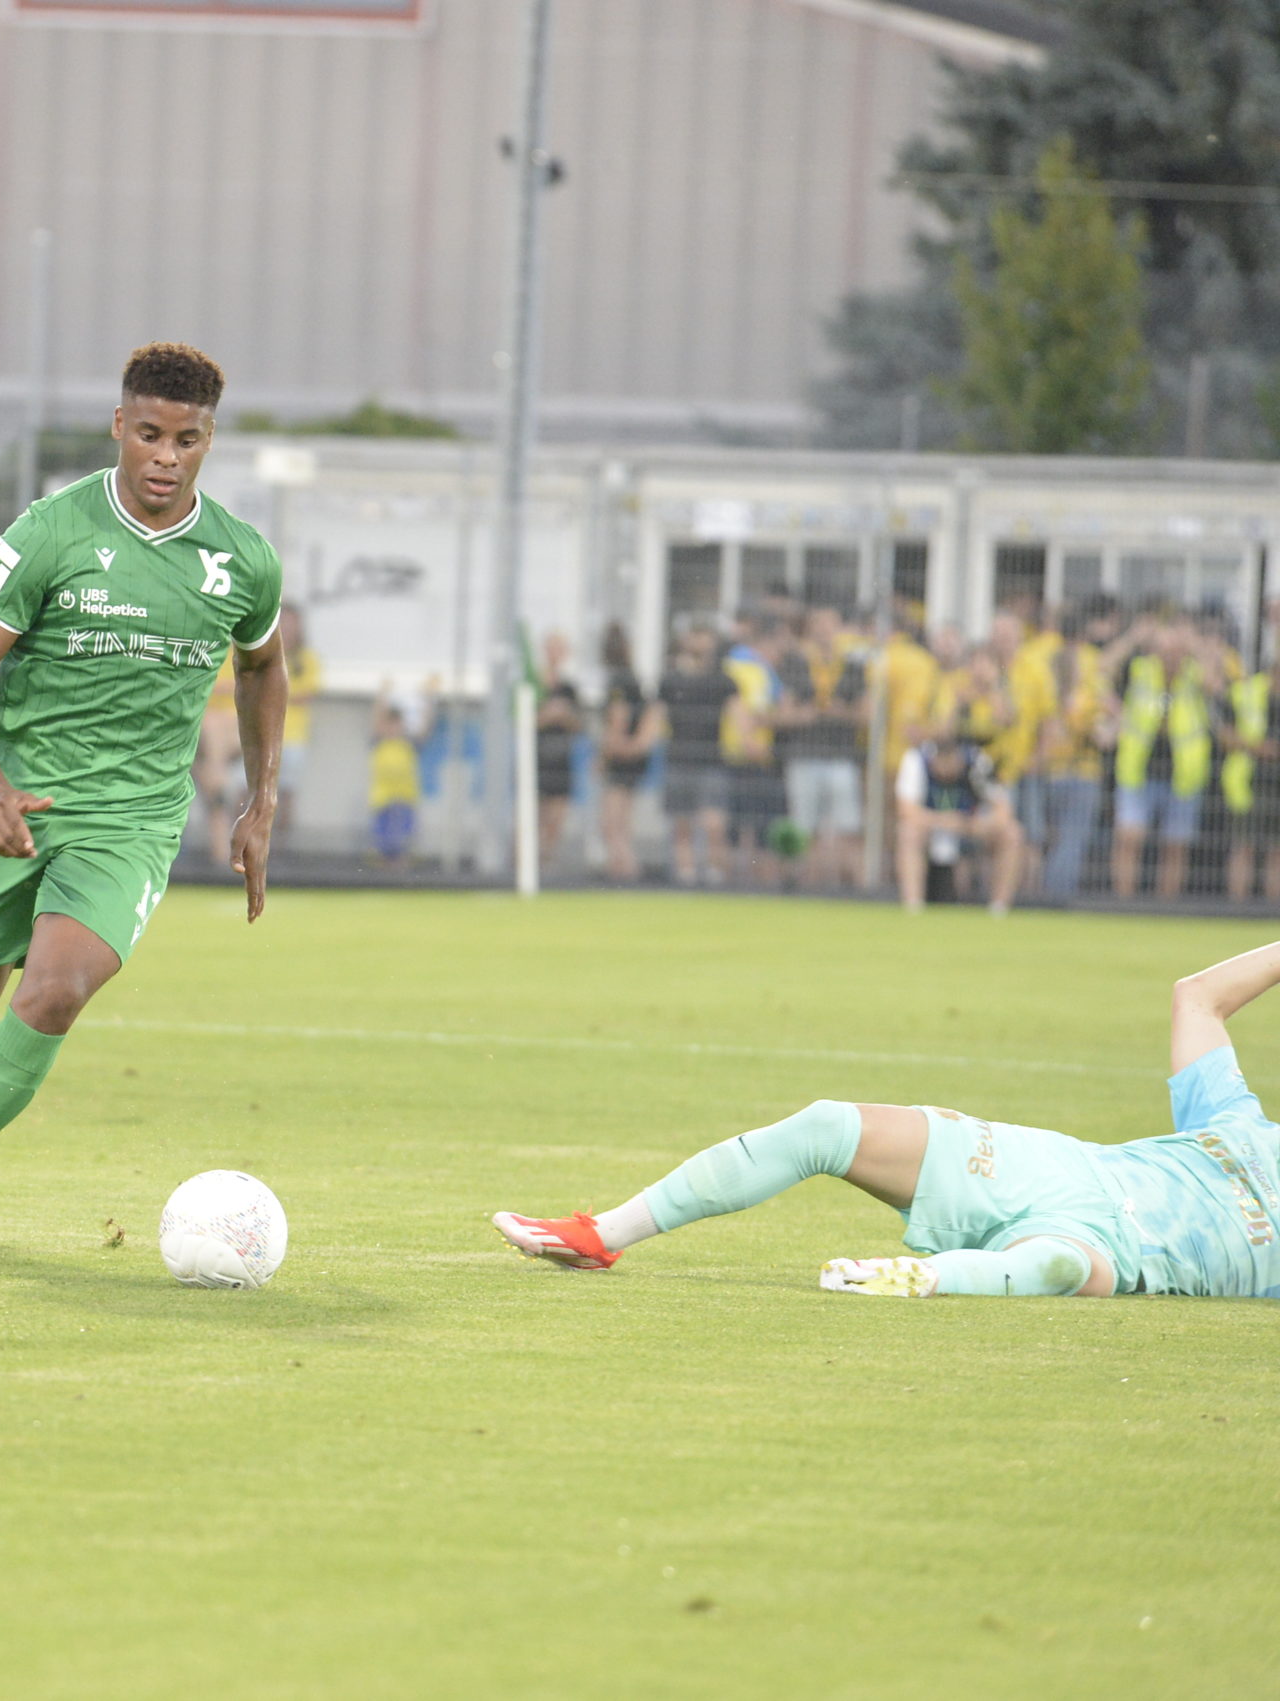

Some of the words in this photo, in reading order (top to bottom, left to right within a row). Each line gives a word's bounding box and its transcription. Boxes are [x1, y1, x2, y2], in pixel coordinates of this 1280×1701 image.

[80, 588, 109, 602] UBS
[80, 601, 148, 618] Helpetica
[66, 630, 220, 667] KINETIK
